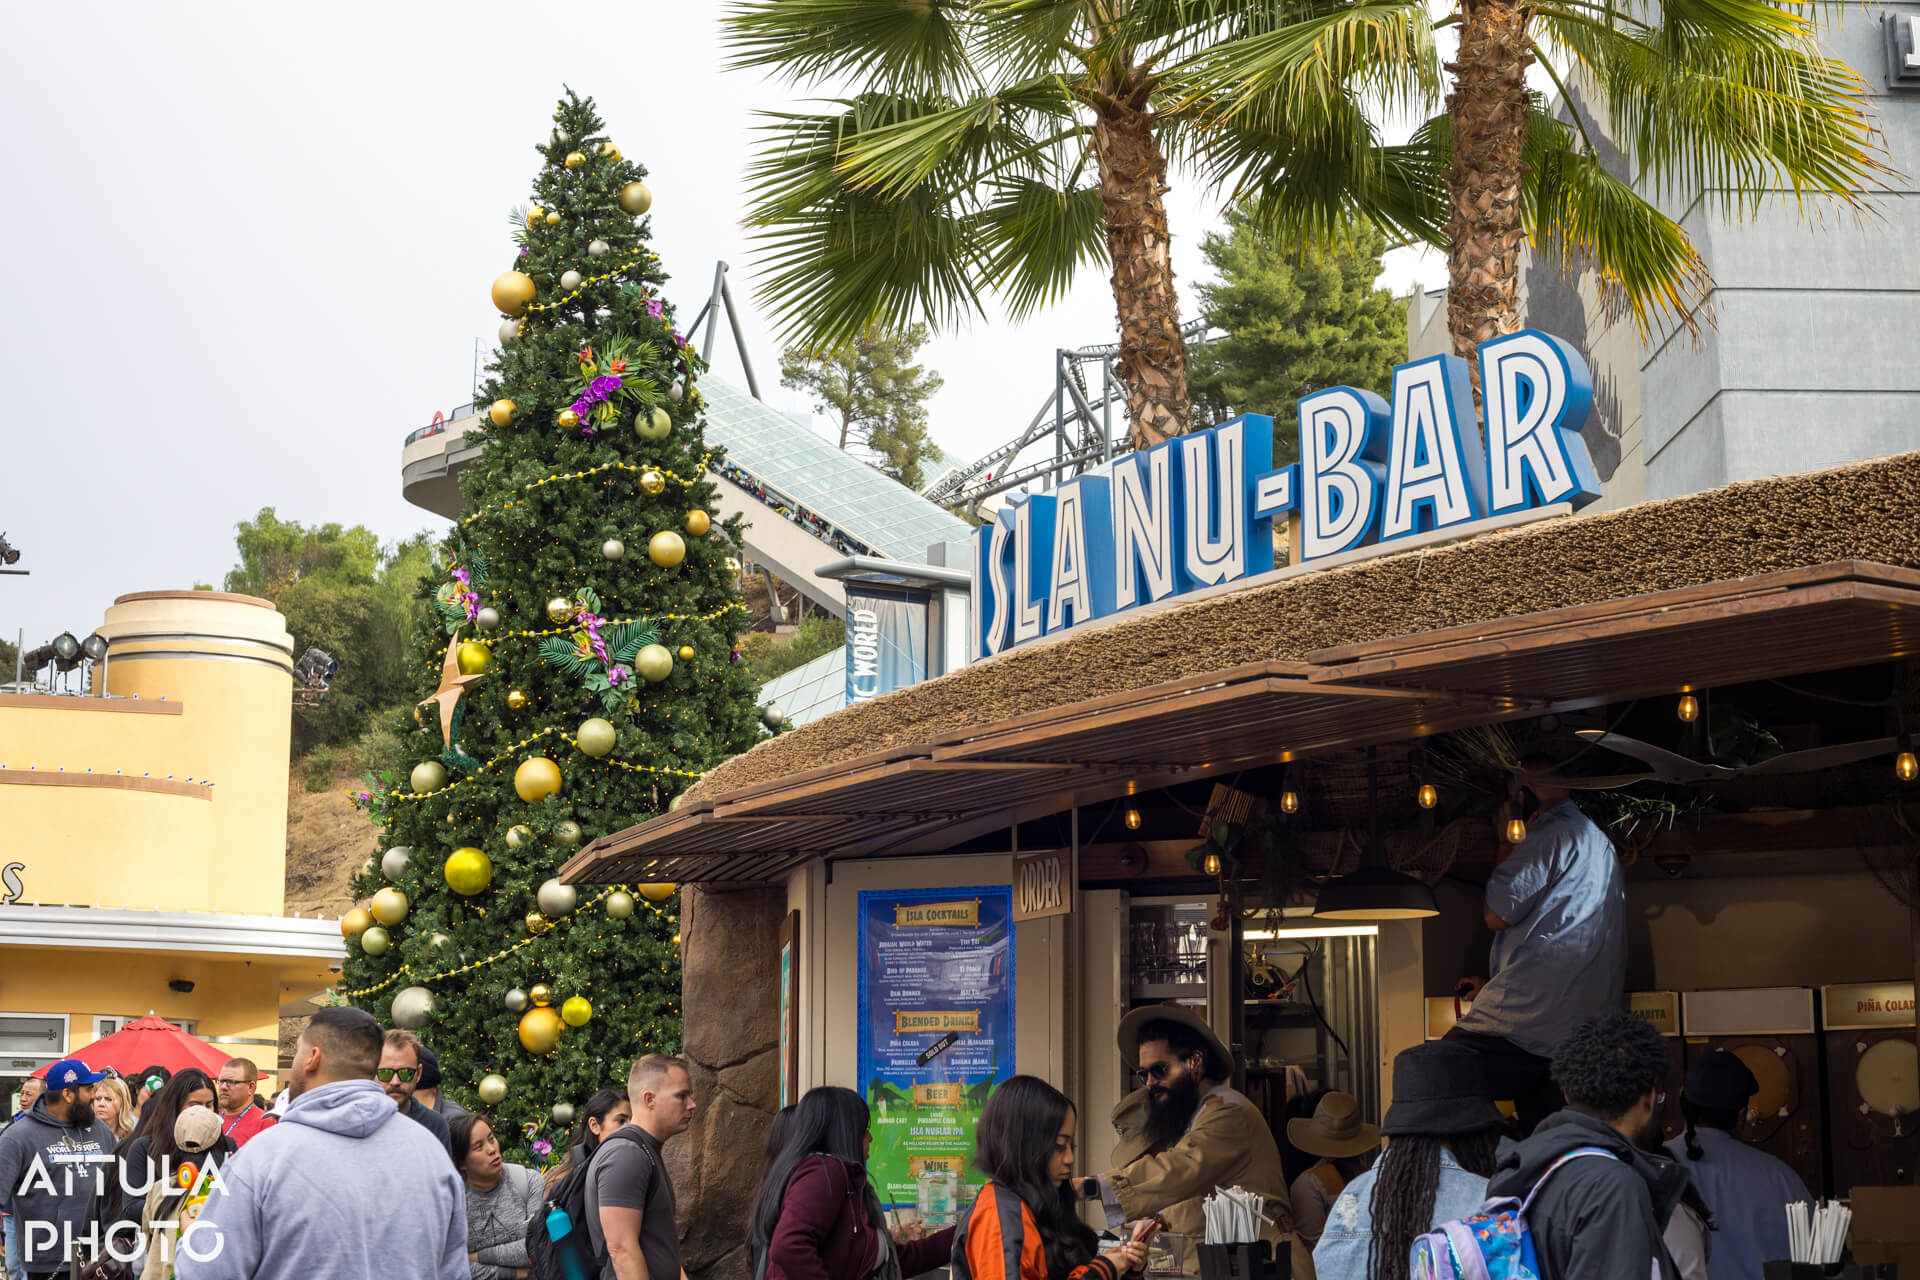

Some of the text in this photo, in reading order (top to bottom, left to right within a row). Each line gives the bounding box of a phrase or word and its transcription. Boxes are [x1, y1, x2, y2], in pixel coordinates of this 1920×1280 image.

[969, 328, 1602, 663] ISLA NU-BAR
[853, 609, 878, 677] WORLD
[1020, 857, 1061, 913] ORDER
[906, 909, 969, 922] ISLA COCKTAILS
[1857, 998, 1882, 1013] PIÑA
[901, 1015, 975, 1028] BLENDED DRINKS
[925, 1046, 940, 1059] SOLD
[938, 1039, 949, 1052] OUT
[926, 1088, 948, 1100] BEER
[923, 1160, 949, 1171] WINE
